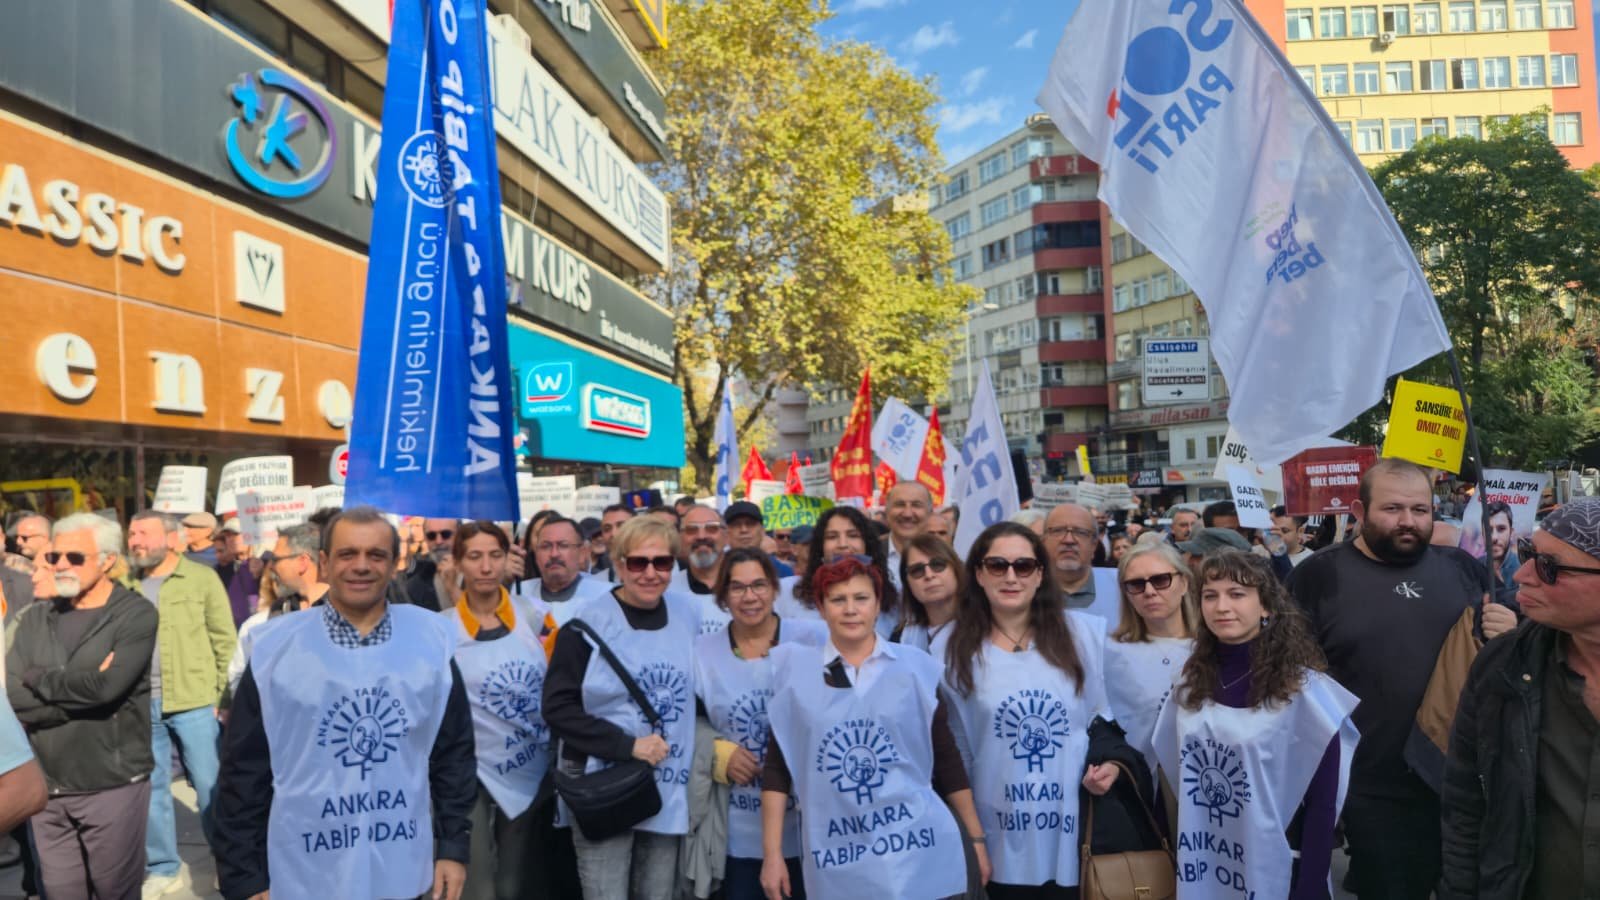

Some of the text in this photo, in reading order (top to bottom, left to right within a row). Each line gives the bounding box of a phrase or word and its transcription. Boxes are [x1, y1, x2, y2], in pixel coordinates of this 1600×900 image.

[571, 113, 643, 230] KURS
[532, 232, 593, 313] KURS
[528, 404, 573, 413] watsons
[1415, 399, 1452, 419] SANSÜRE
[1416, 419, 1441, 435] OMUZ
[1225, 442, 1248, 464] SUÇ
[1236, 485, 1258, 495] GAZE
[1479, 478, 1506, 490] MAİL
[1237, 499, 1254, 510] SUÇ
[317, 695, 349, 748] ANKARA
[354, 686, 390, 699] TABİP
[993, 695, 1016, 739] ANKARA
[1019, 688, 1052, 700] TABİP
[815, 727, 842, 773] ANKARA
[844, 718, 875, 729] TABİP
[729, 792, 762, 812] ABİP
[827, 802, 913, 838] ANKARA
[1035, 811, 1075, 834] ODSI
[302, 824, 360, 854] TABİP
[811, 827, 936, 870] TABİP ODASI
[1178, 831, 1246, 865] ANKAR
[1176, 858, 1208, 883] ABİP
